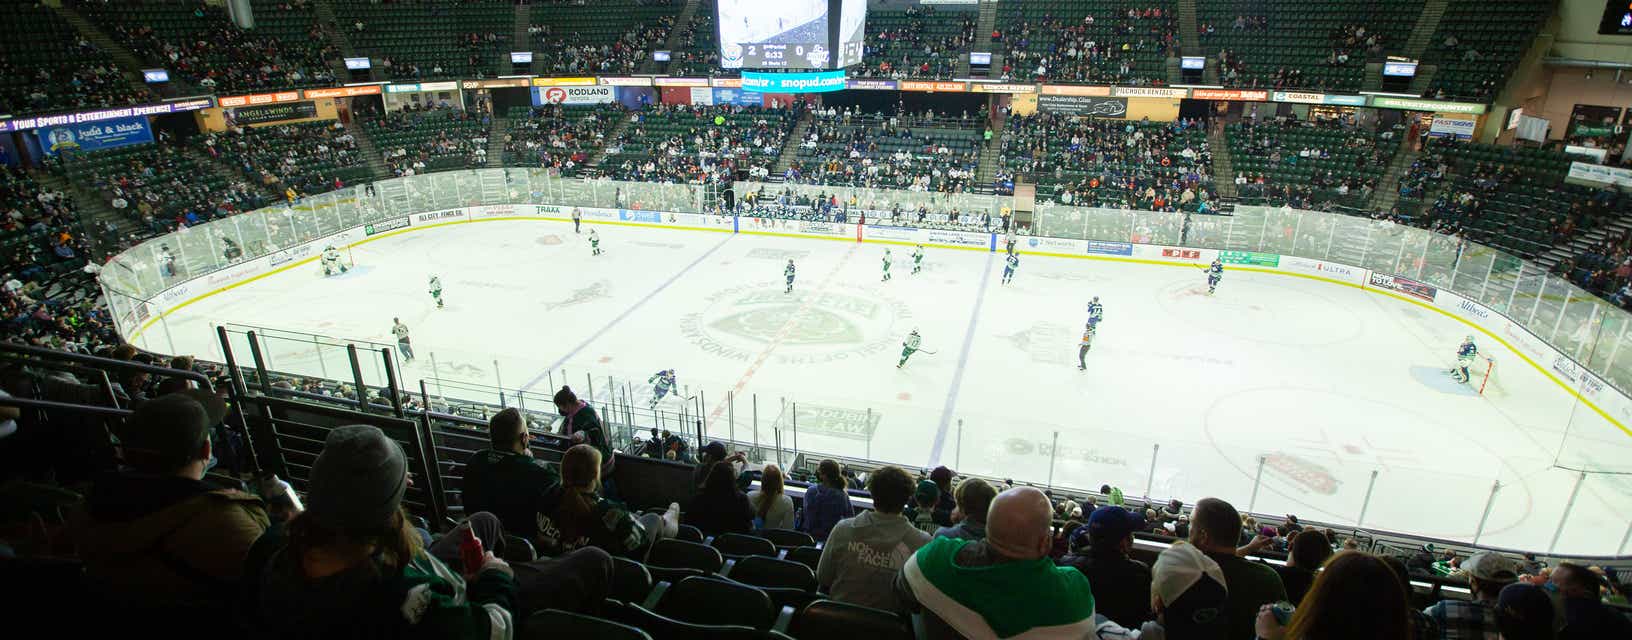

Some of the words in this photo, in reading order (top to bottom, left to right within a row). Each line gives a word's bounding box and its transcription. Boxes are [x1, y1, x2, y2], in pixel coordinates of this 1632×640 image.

[747, 45, 757, 56] 2
[795, 45, 804, 56] 0
[568, 87, 609, 96] RODLAND
[1148, 88, 1173, 97] RENTALS
[1288, 93, 1320, 101] COASTAL
[12, 118, 37, 131] YOUR
[37, 114, 68, 128] SPORTS
[76, 107, 133, 123] ENTERTAINMENT
[78, 125, 103, 140] judd
[104, 124, 114, 134] &
[116, 121, 144, 132] black
[1372, 271, 1394, 282] MORE
[857, 551, 890, 569] FACE
